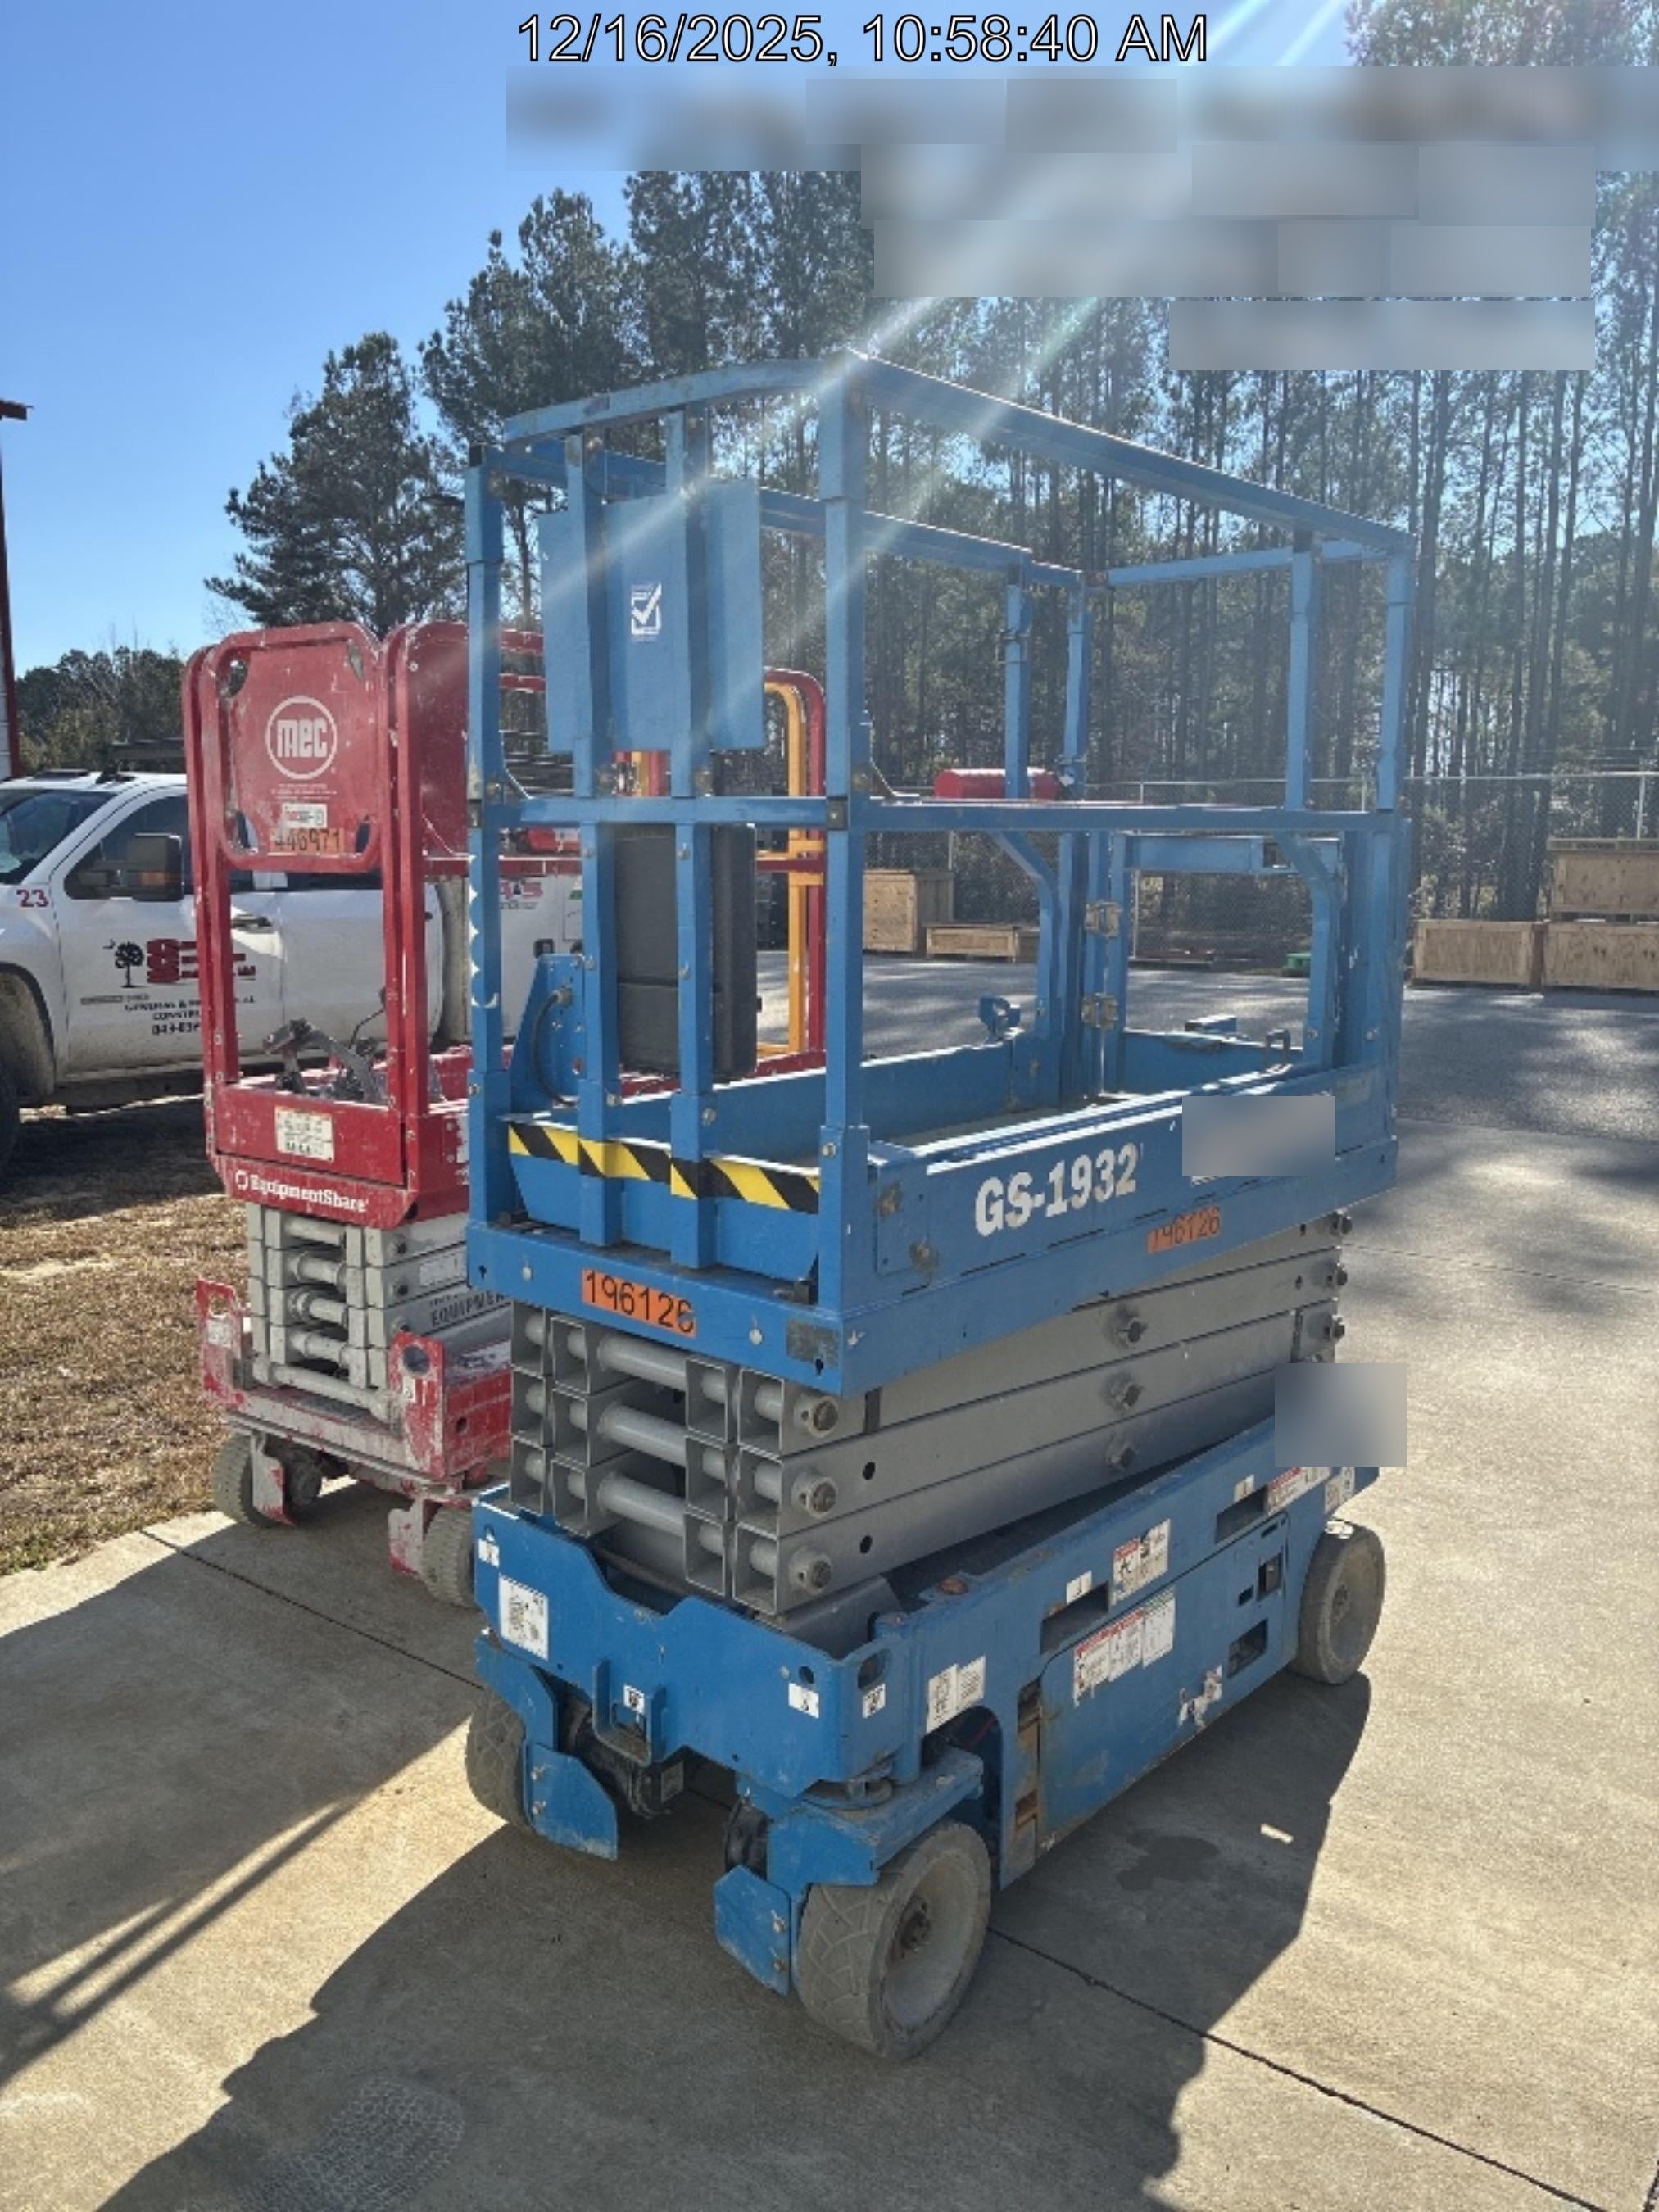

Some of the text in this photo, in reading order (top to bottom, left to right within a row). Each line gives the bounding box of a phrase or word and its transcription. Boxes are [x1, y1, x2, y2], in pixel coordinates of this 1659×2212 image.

[16, 888, 49, 907] 23
[250, 1173, 368, 1213] EquipmentShare
[975, 1143, 1138, 1237] GS-1932
[1149, 1206, 1220, 1250] 196126
[432, 1291, 505, 1328] EQUIPMEN
[586, 1270, 694, 1333] 196126
